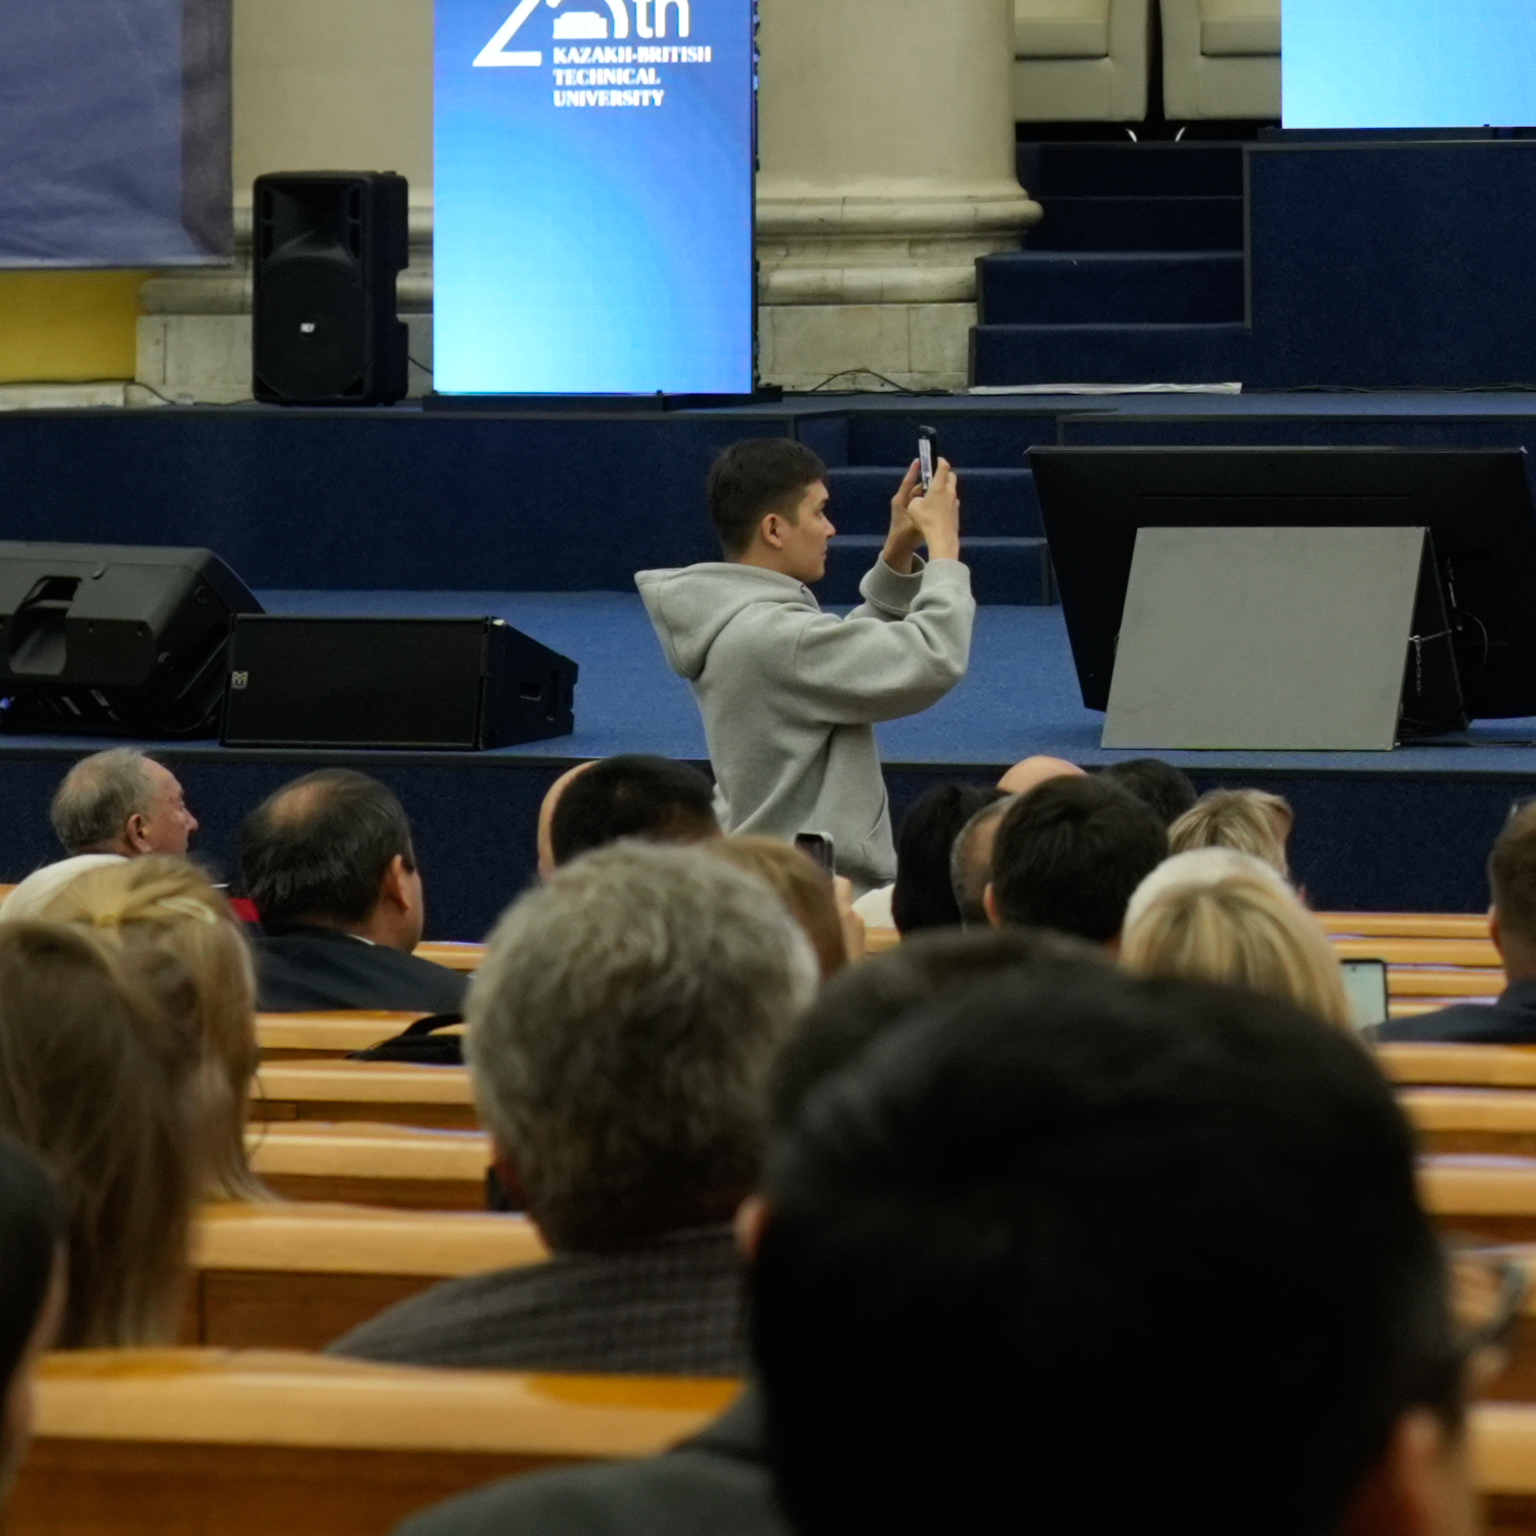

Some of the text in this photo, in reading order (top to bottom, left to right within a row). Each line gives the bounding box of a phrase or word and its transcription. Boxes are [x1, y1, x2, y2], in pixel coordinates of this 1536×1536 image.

[554, 47, 711, 63] KAZAKH-BRITISH
[554, 68, 660, 85] TECHNICAL
[554, 90, 664, 106] UNIVERSITY
